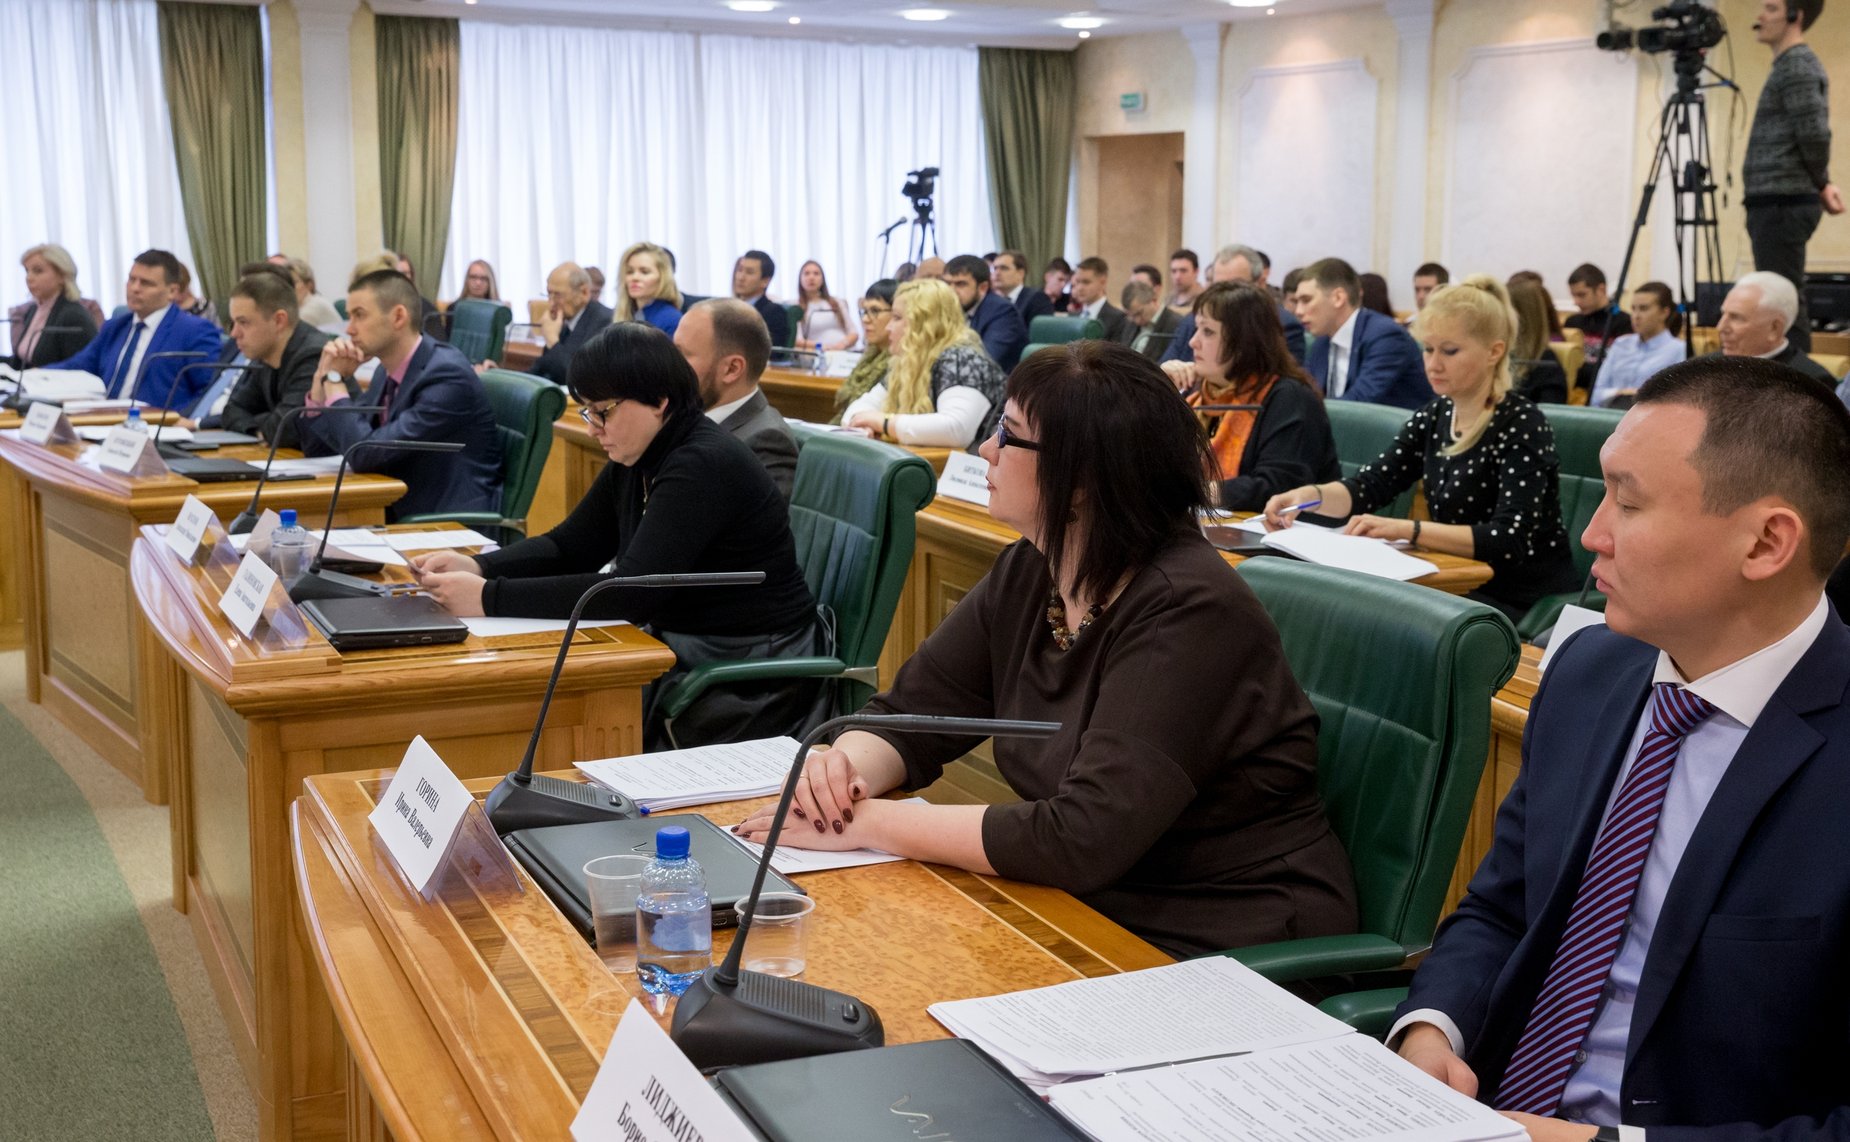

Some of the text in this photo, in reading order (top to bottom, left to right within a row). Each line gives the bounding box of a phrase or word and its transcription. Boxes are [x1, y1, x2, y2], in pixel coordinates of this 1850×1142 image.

[416, 777, 440, 812] ГОРИНА
[395, 791, 433, 848] Ирина Валерьевна
